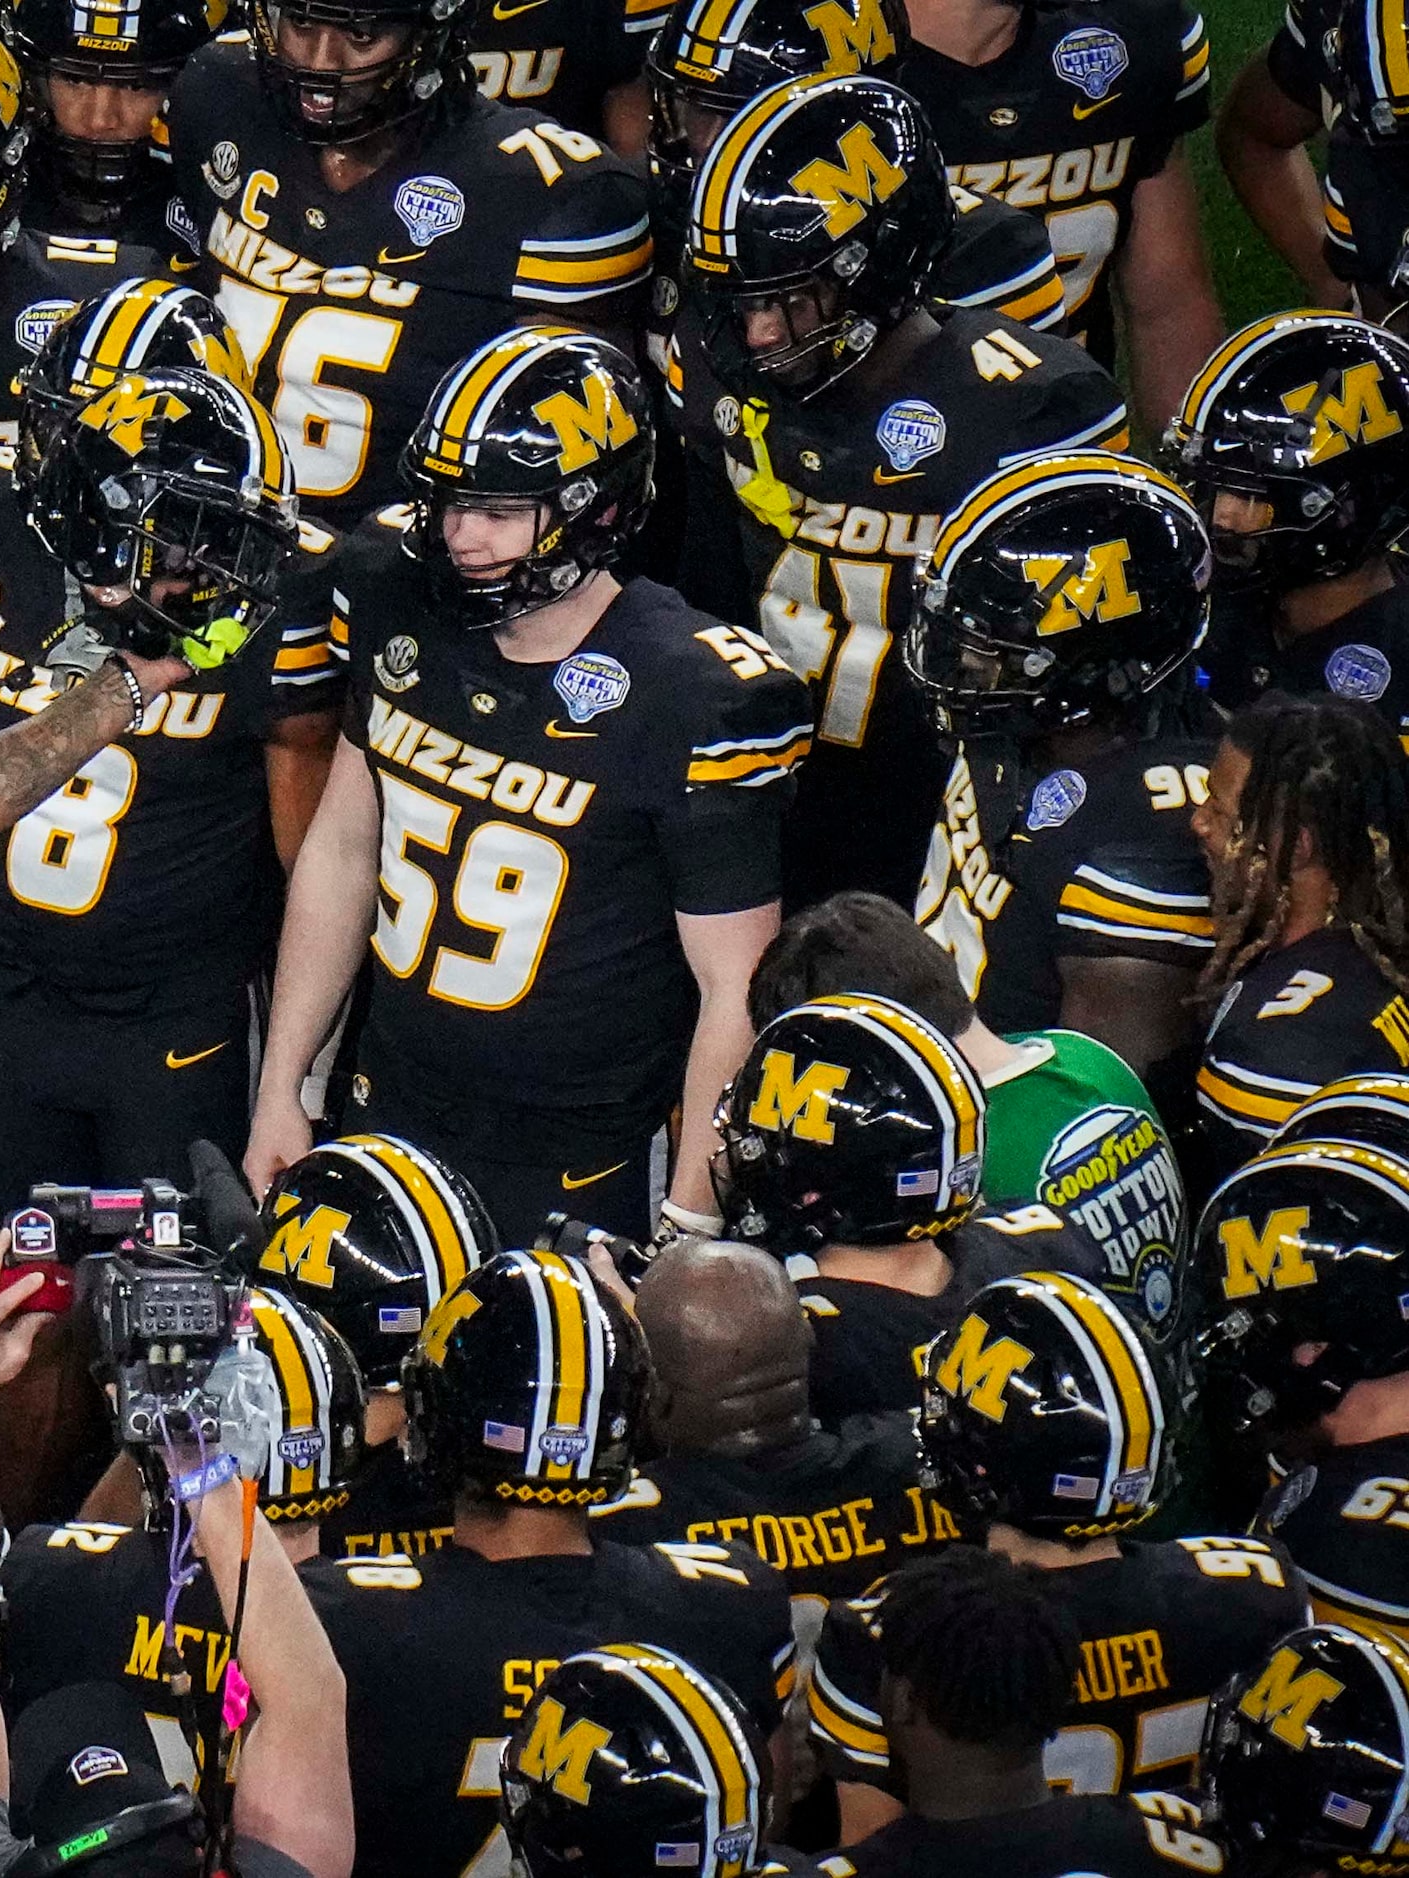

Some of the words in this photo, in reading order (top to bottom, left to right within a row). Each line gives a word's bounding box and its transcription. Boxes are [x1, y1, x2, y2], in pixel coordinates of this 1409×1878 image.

[76, 35, 131, 52] MIZZOU
[213, 143, 239, 179] SEC
[241, 170, 280, 230] C
[497, 122, 603, 187] 76
[789, 120, 908, 241] M
[403, 190, 461, 223] COTTON
[208, 208, 421, 308] MIZZOU
[532, 368, 639, 475] M
[885, 416, 940, 447] COTTON
[1281, 361, 1404, 467] M
[1022, 538, 1142, 637] M
[562, 668, 626, 702] COTTON
[760, 542, 893, 748] 41
[368, 694, 596, 827] MIZZOU
[6, 744, 138, 917] 8
[369, 768, 569, 1012] 59
[1256, 968, 1334, 1020] 3
[749, 1047, 852, 1145] M
[1045, 1120, 1159, 1208] GOODYEAR
[1070, 1147, 1182, 1242] OTTON
[259, 1191, 352, 1289] M
[1101, 1200, 1181, 1279] BOWL
[1218, 1205, 1318, 1300] M
[936, 1312, 1036, 1424] M
[1238, 1645, 1347, 1752] M
[517, 1695, 613, 1806] M
